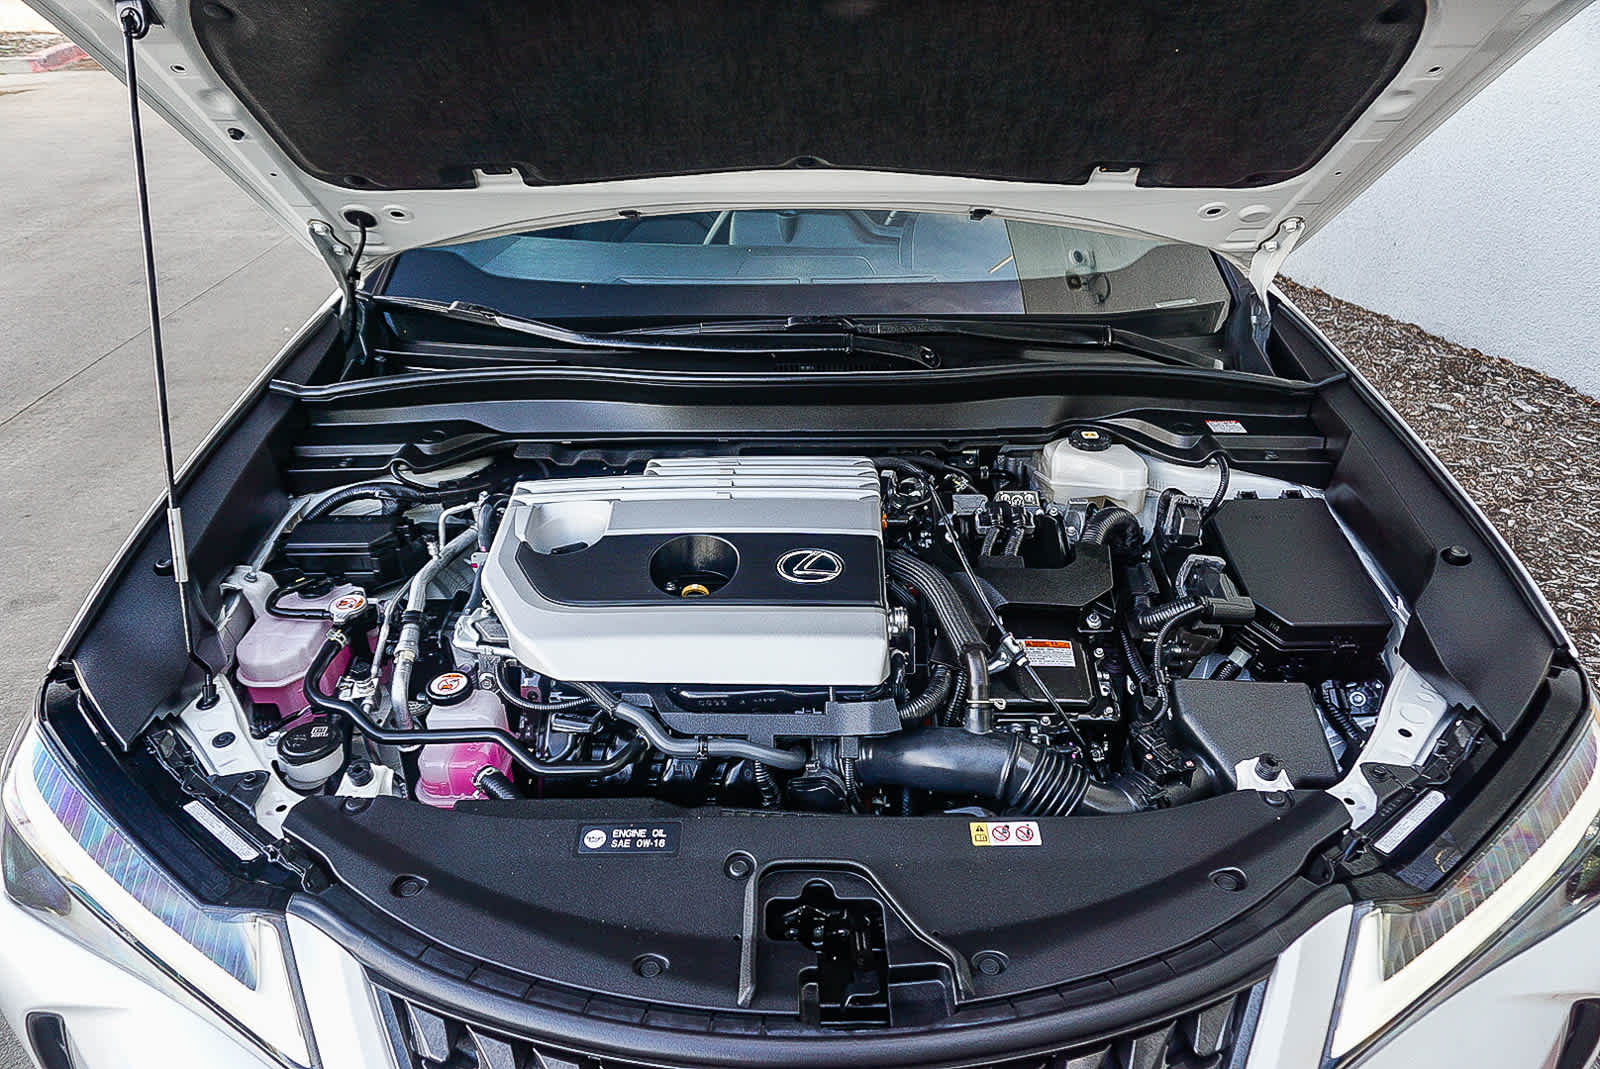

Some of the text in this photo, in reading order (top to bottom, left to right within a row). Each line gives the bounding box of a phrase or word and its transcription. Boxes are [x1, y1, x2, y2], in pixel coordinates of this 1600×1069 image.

[612, 829, 667, 838] ENGINE OIL
[611, 839, 631, 848] SAE
